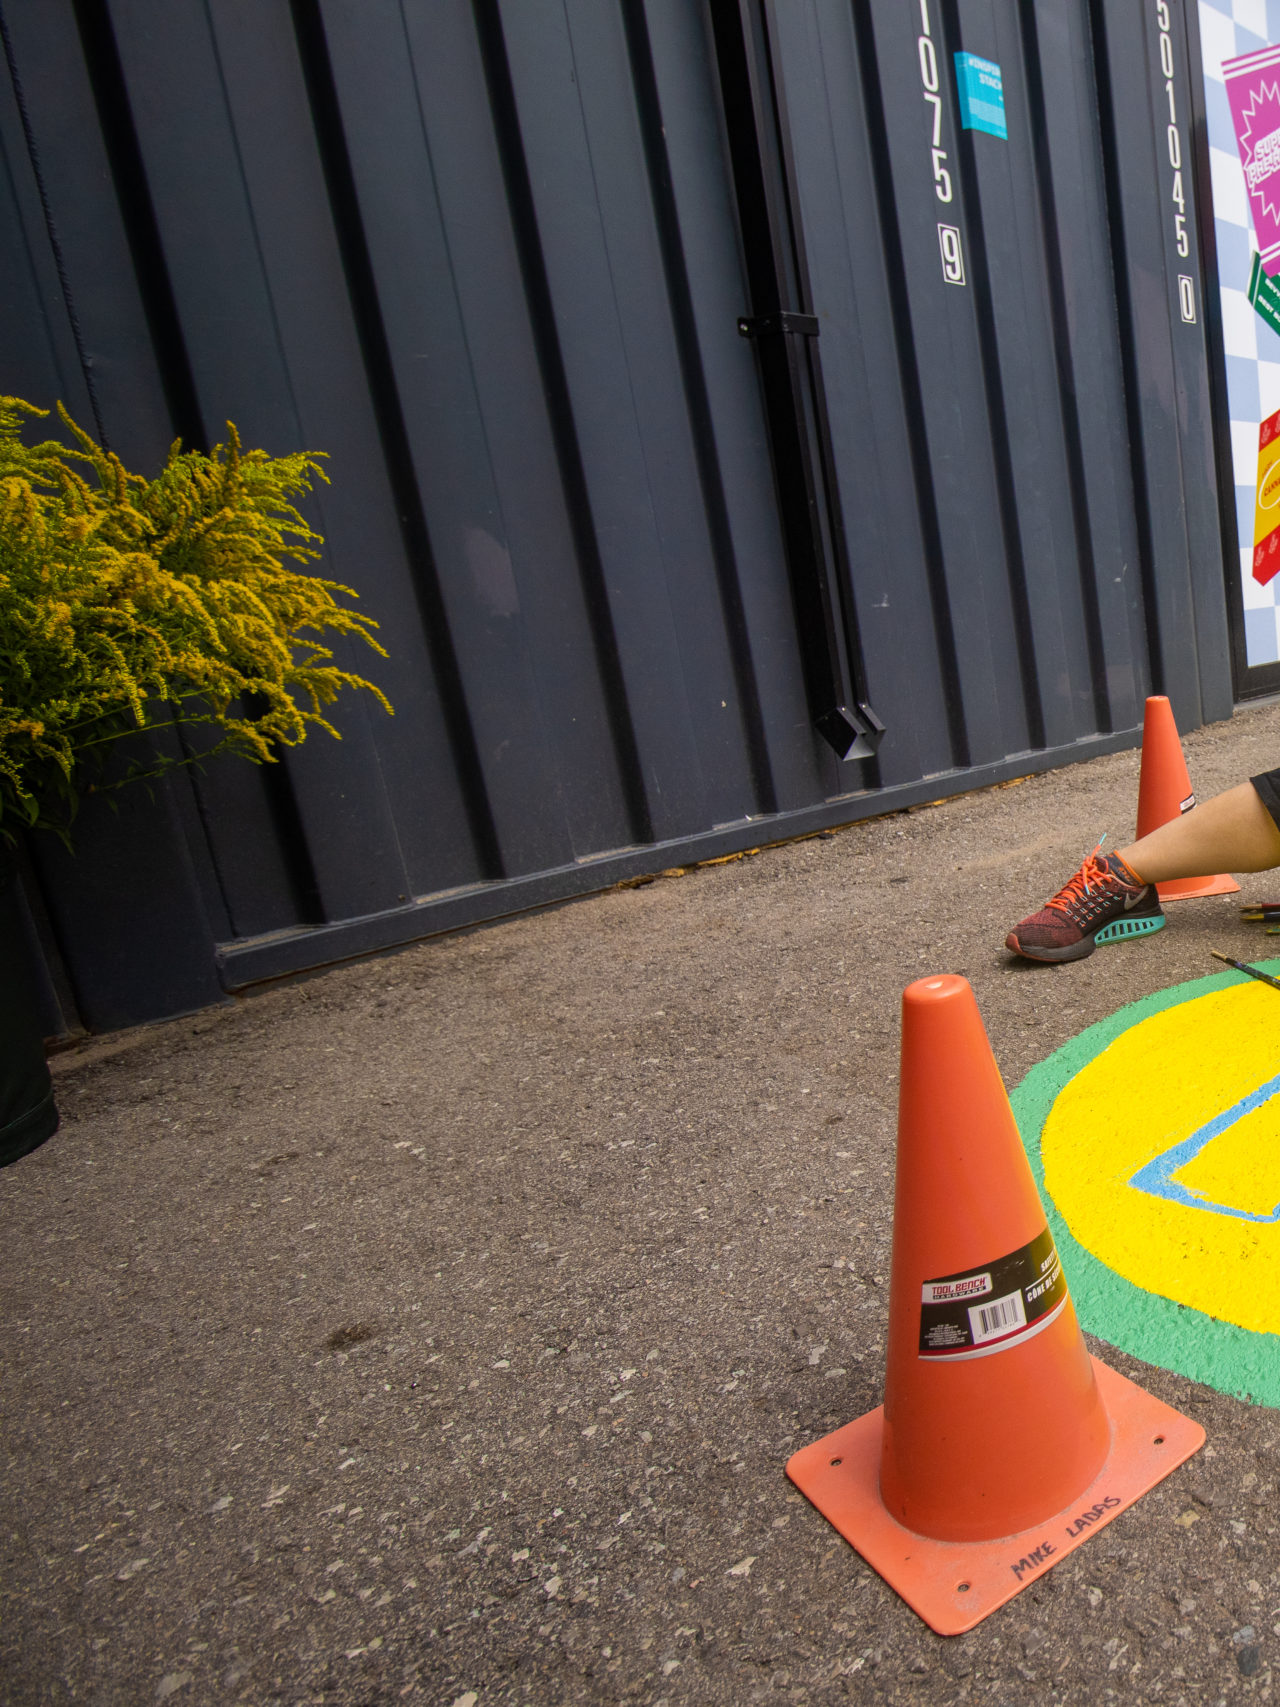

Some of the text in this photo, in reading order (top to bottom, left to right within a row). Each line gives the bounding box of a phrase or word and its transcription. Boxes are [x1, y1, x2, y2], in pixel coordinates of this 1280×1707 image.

[942, 228, 963, 281] 9
[932, 1277, 986, 1295] TOOL BENCH
[932, 1286, 987, 1300] HARDWARE
[1010, 1496, 1122, 1582] MIKE LADAS
